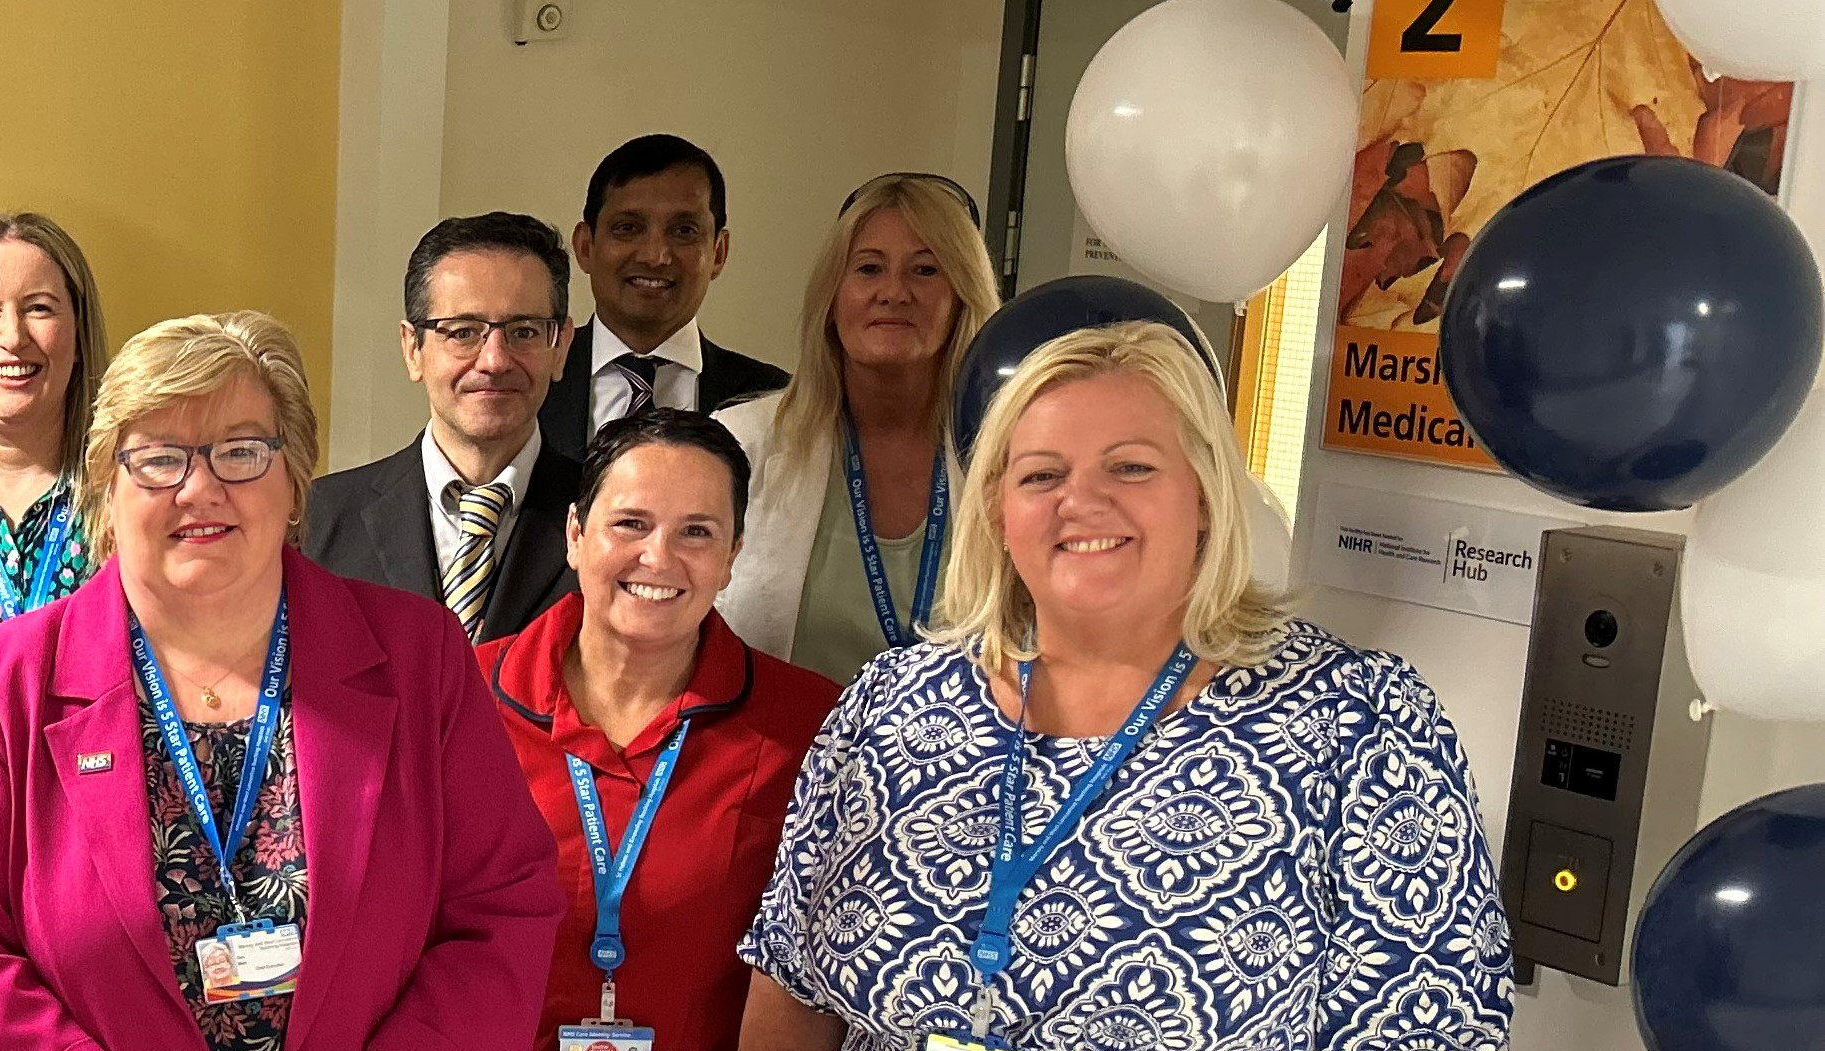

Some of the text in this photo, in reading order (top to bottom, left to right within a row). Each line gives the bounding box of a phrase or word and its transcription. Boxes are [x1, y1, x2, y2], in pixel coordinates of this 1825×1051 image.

[1338, 399, 1474, 448] Medica
[933, 497, 944, 517] Our
[1338, 534, 1372, 554] NIHR
[1455, 539, 1532, 570] Research
[852, 478, 897, 641] Our Vision is 5 Star Patient Care
[1452, 559, 1488, 582] Hub
[269, 637, 288, 675] Vision
[264, 675, 280, 698] Our
[1125, 650, 1192, 736] Our Vision is 5
[132, 637, 210, 825] Our Vision is 5 Star Patient Care
[80, 756, 108, 770] NHS
[1011, 754, 1021, 763] 5
[1103, 743, 1122, 762] NHS
[574, 767, 584, 776] 5
[1006, 765, 1019, 789] Star
[577, 778, 593, 801] Star
[584, 802, 601, 845] Patient
[1004, 790, 1018, 833] Patient
[1001, 835, 1016, 861] Care
[594, 847, 606, 875] Care
